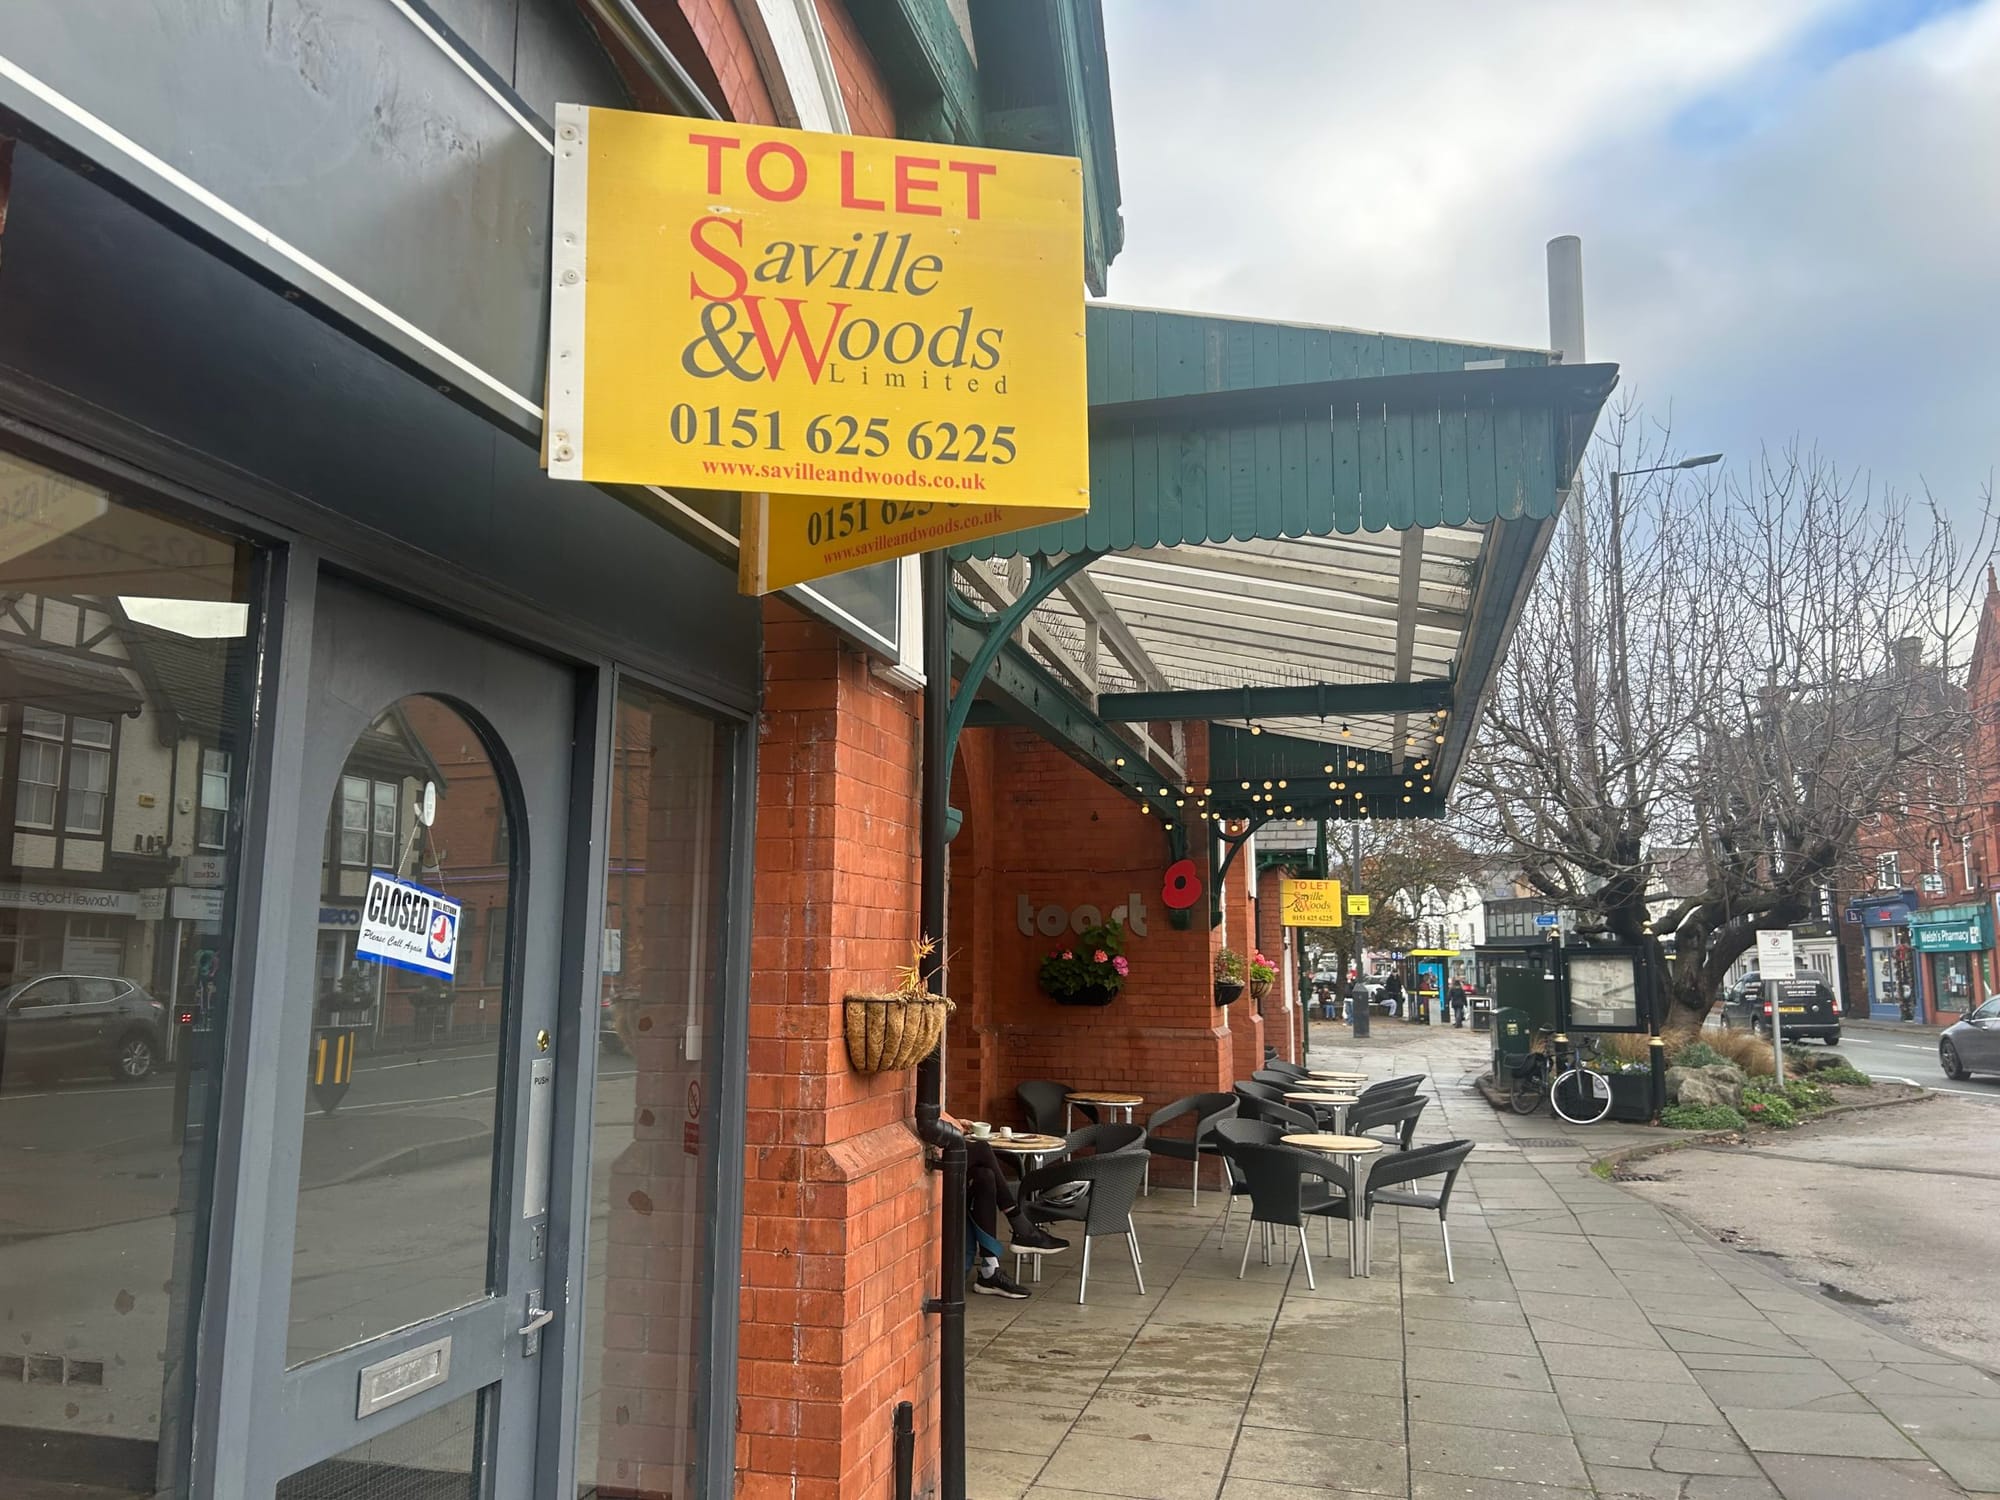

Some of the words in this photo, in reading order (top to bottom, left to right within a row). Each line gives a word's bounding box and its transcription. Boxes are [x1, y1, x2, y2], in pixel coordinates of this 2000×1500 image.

[689, 133, 808, 202] TO
[841, 150, 997, 220] LET
[689, 216, 943, 302] Saville
[829, 363, 1008, 394] Limited
[670, 403, 785, 450] 0151
[806, 414, 890, 458] 625
[908, 420, 1017, 465] 6225
[702, 461, 987, 491] www.savilleandwoods.co.uk
[807, 498, 869, 546] 0151
[823, 509, 1003, 565] www.savilleandwoods.co.uk
[367, 881, 430, 935] CLOSED
[1293, 881, 1307, 890] TO
[1310, 881, 1329, 890] LET
[363, 929, 386, 943] Please
[387, 936, 402, 947] Call
[403, 941, 423, 953] Again
